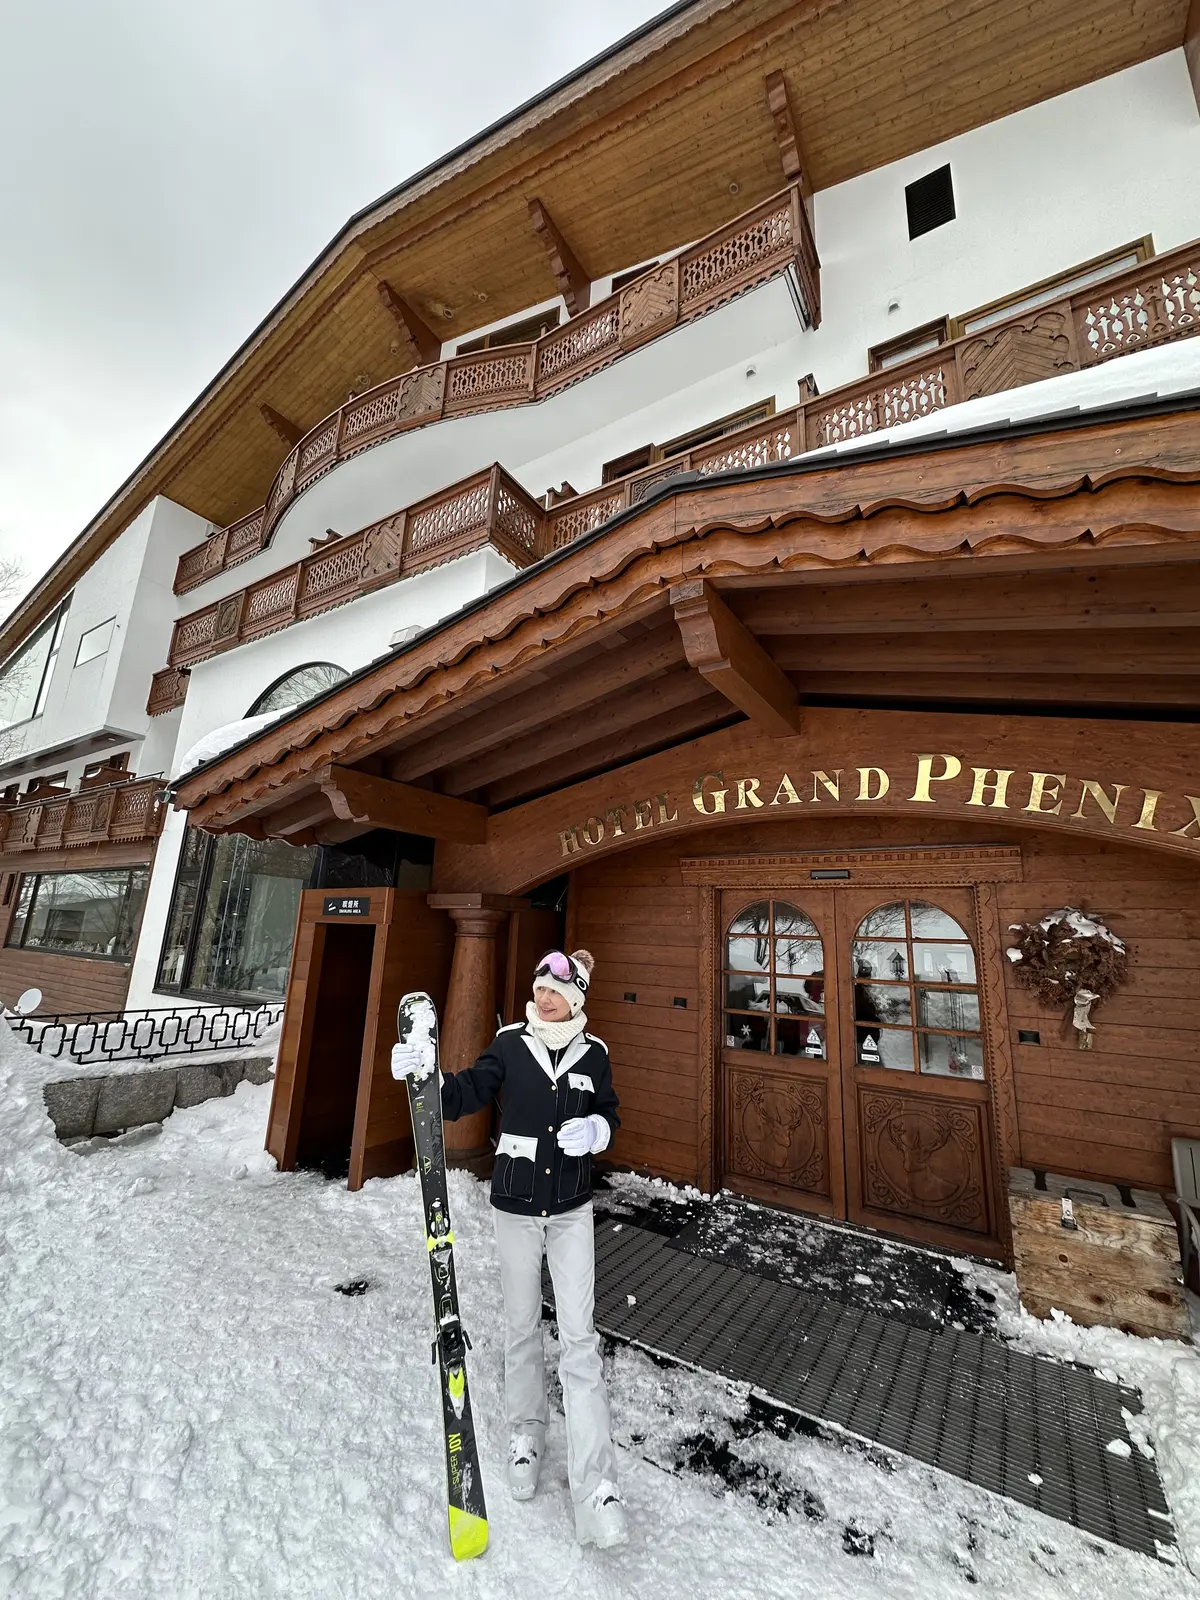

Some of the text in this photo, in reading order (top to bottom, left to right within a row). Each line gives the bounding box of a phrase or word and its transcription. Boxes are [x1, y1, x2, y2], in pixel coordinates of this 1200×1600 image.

[557, 793, 679, 857] HOTEL
[692, 767, 891, 815] GRAND
[448, 1432, 462, 1485] SUPER JOY
